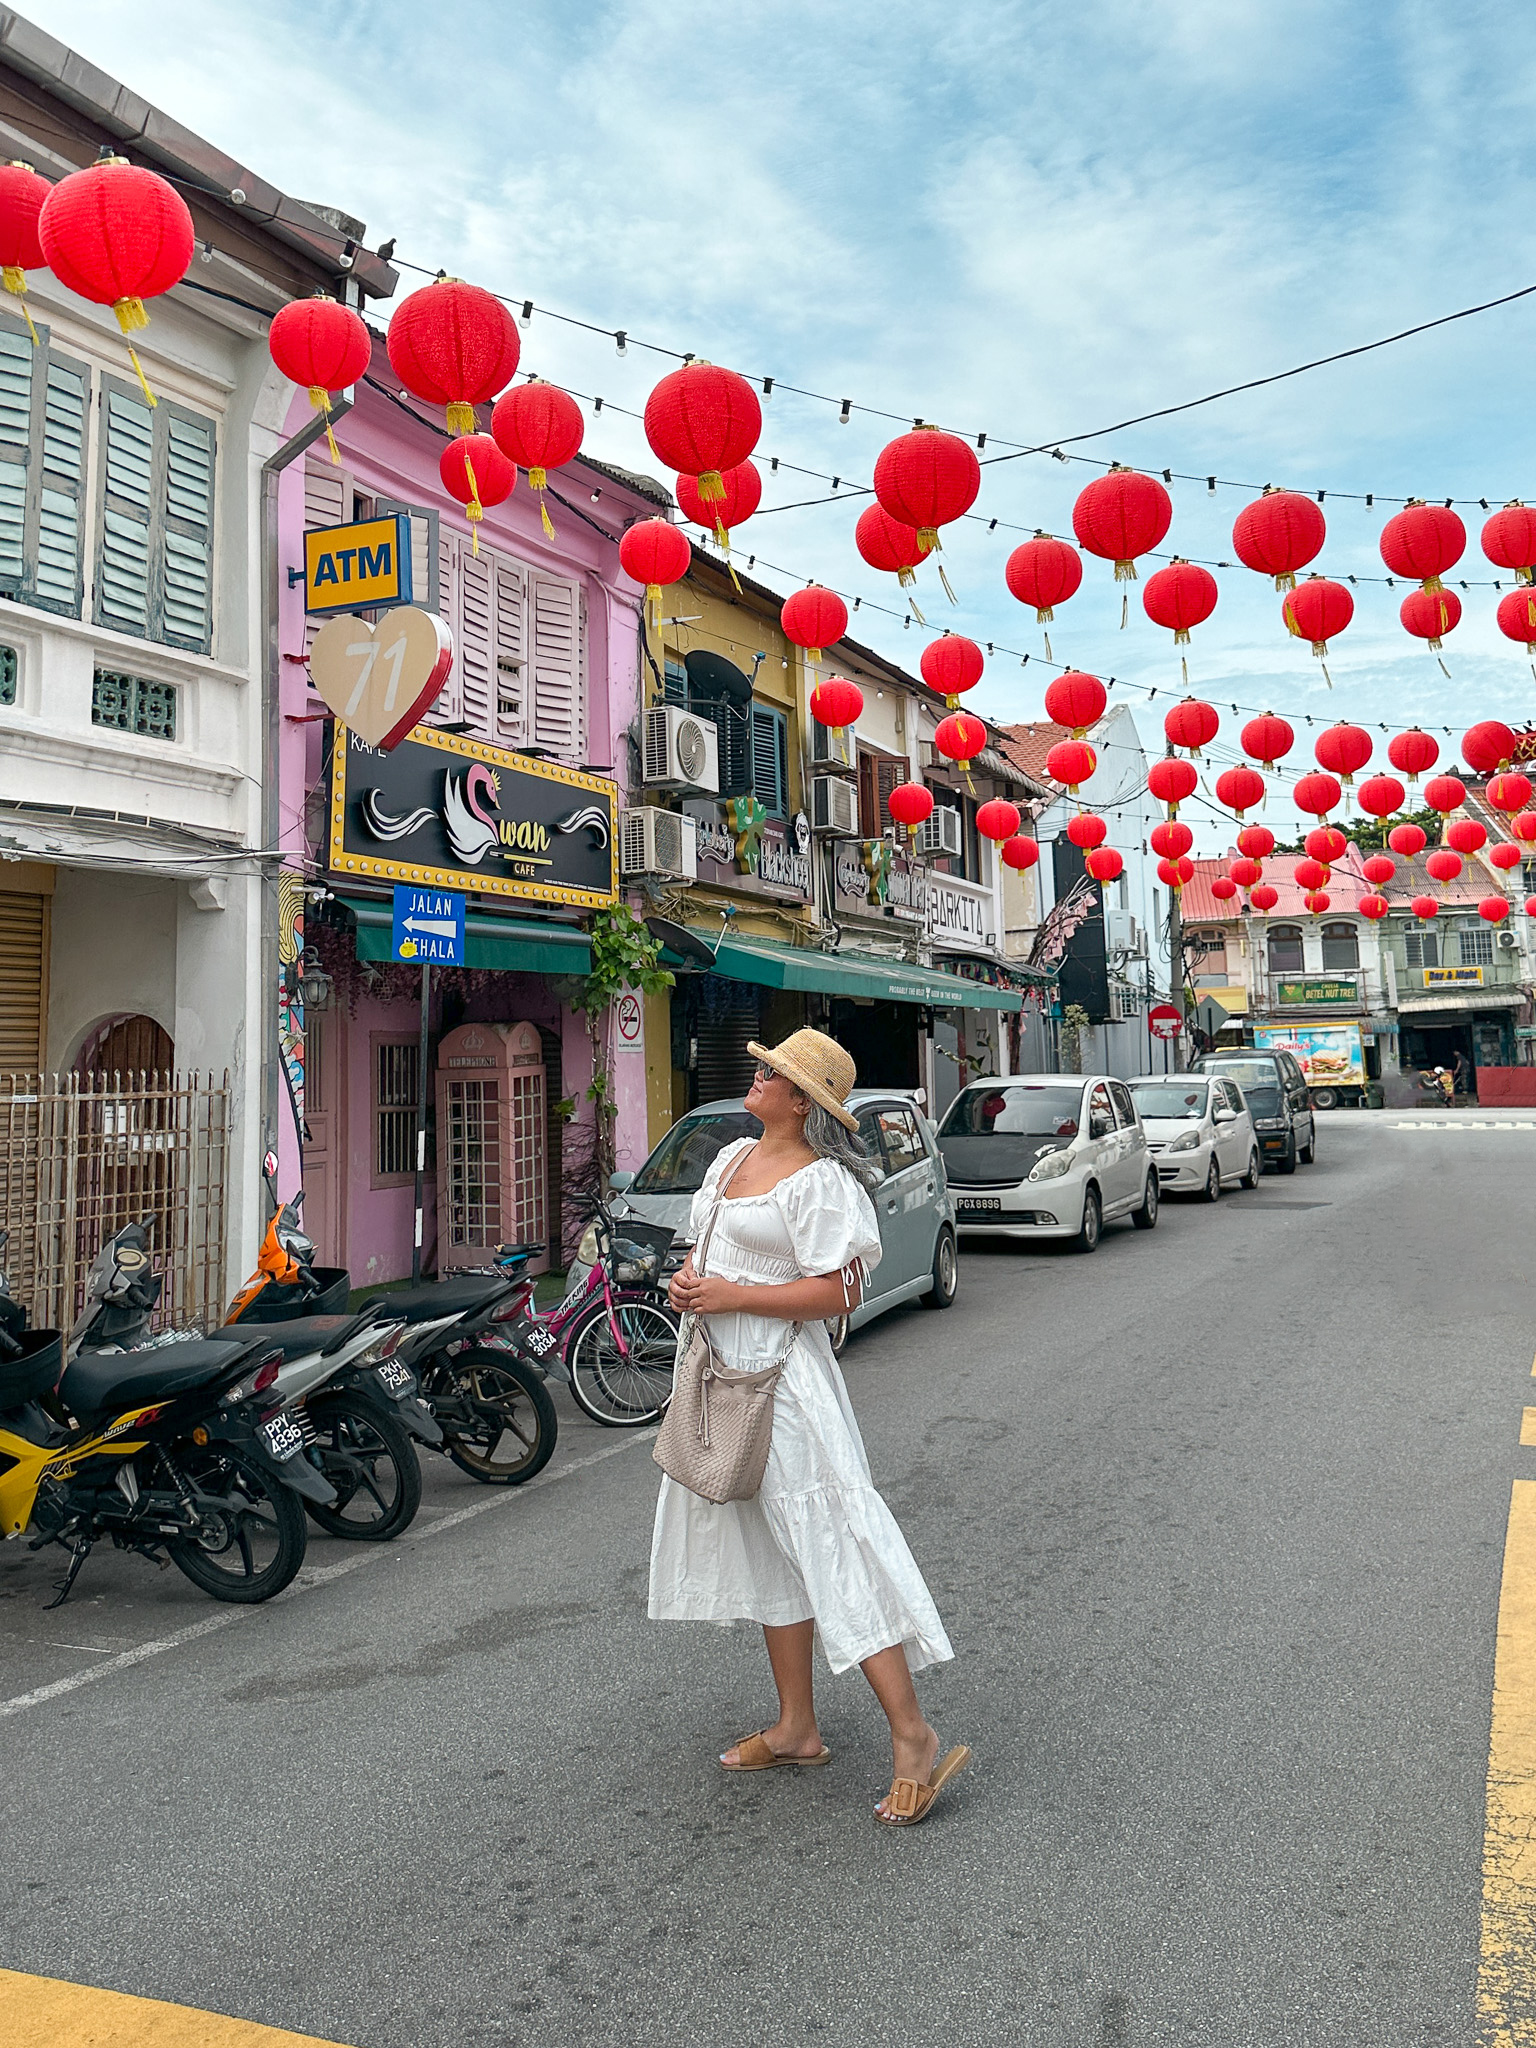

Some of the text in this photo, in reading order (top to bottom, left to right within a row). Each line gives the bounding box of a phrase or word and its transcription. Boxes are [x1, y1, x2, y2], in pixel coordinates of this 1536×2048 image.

[314, 543, 391, 587] ATM
[345, 637, 407, 717] 71
[351, 731, 387, 758] KA
[514, 863, 535, 876] CAFE
[409, 894, 452, 916] JALAN
[931, 887, 983, 935] BARKITA
[889, 985, 907, 995] PROBABLY
[1306, 989, 1324, 999] BETEL
[1325, 988, 1339, 998] NUT
[1340, 987, 1355, 997] TREE
[1275, 1041, 1311, 1052] Daily's
[449, 1056, 495, 1068] TELEPHONE
[958, 1199, 1000, 1209] PGX8896
[527, 1326, 547, 1345] PKJ
[533, 1333, 557, 1356] 3034
[378, 1358, 403, 1379] PKH
[385, 1368, 411, 1390] 7941
[265, 1412, 289, 1439] PPY
[271, 1424, 302, 1453] 4336
